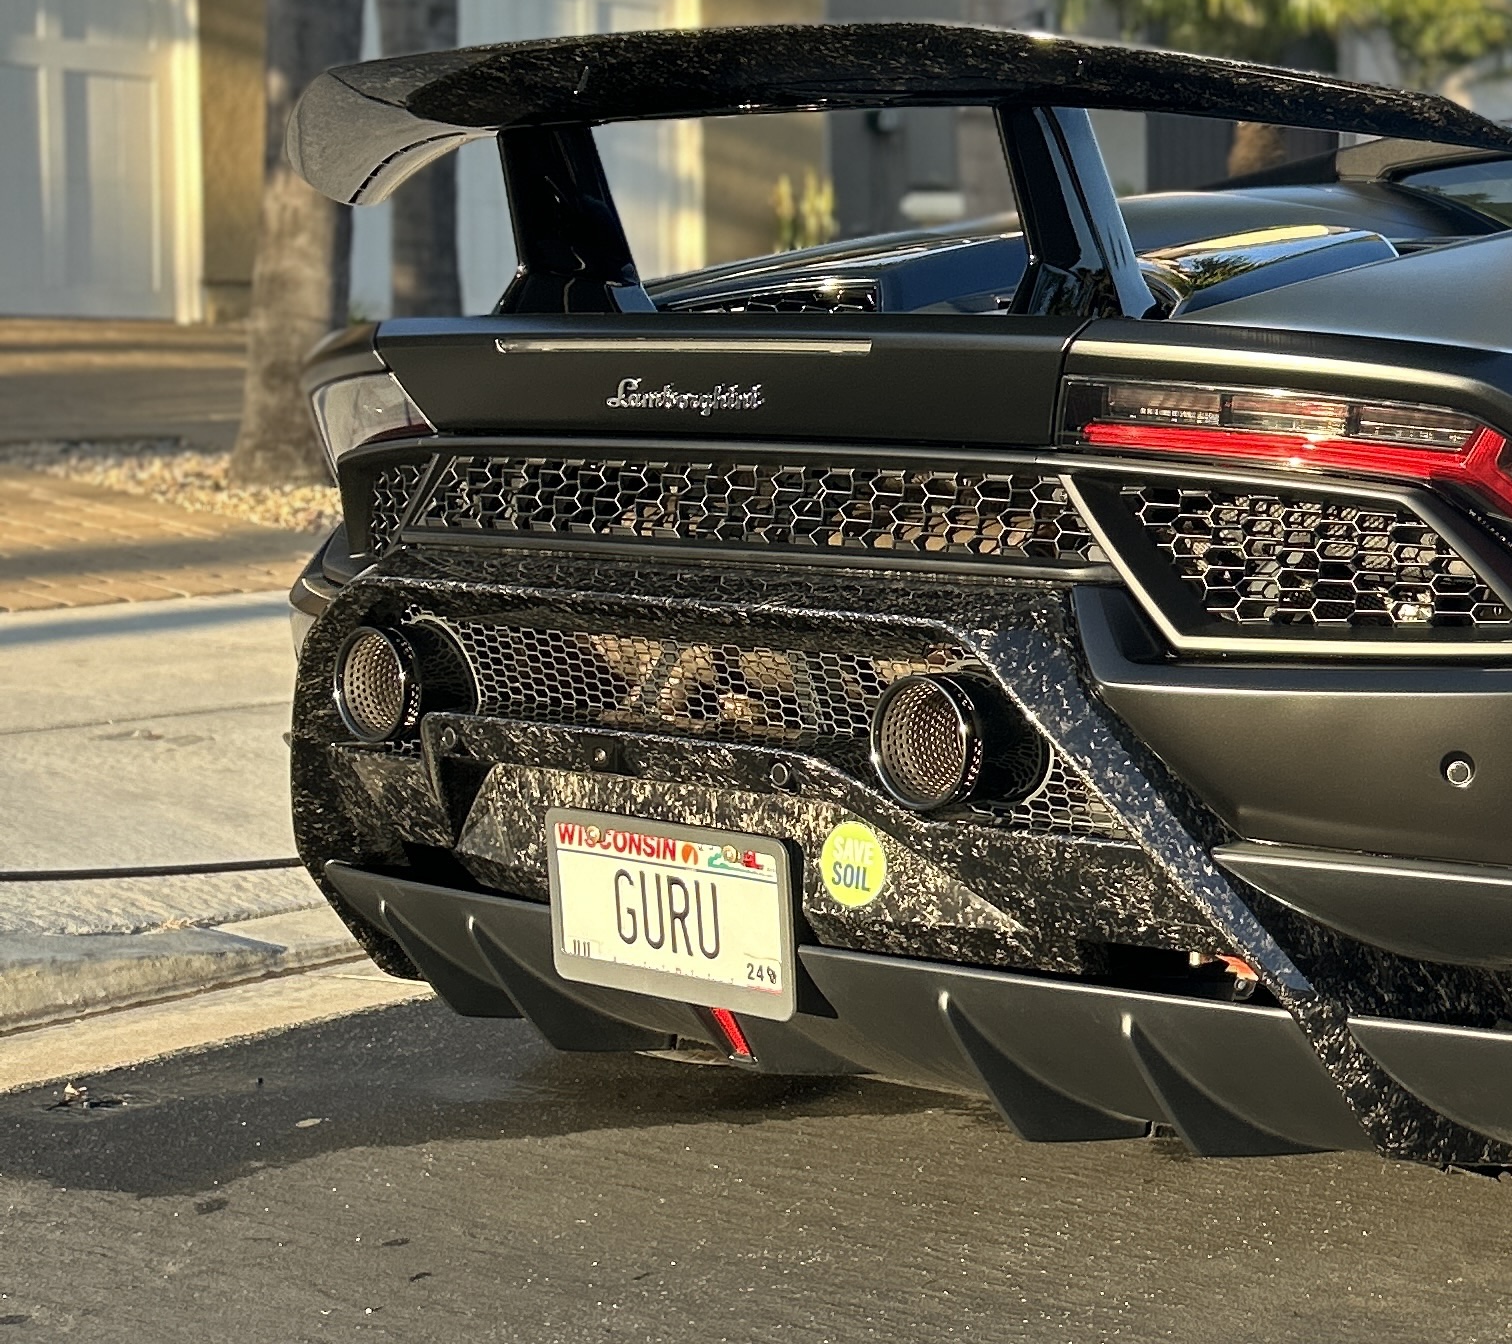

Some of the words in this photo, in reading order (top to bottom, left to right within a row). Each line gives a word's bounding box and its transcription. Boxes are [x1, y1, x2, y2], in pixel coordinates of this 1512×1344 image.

[606, 378, 765, 416] Lamborghini
[832, 835, 874, 866] SAVE
[831, 861, 871, 892] SOIL
[613, 868, 720, 960] GURU
